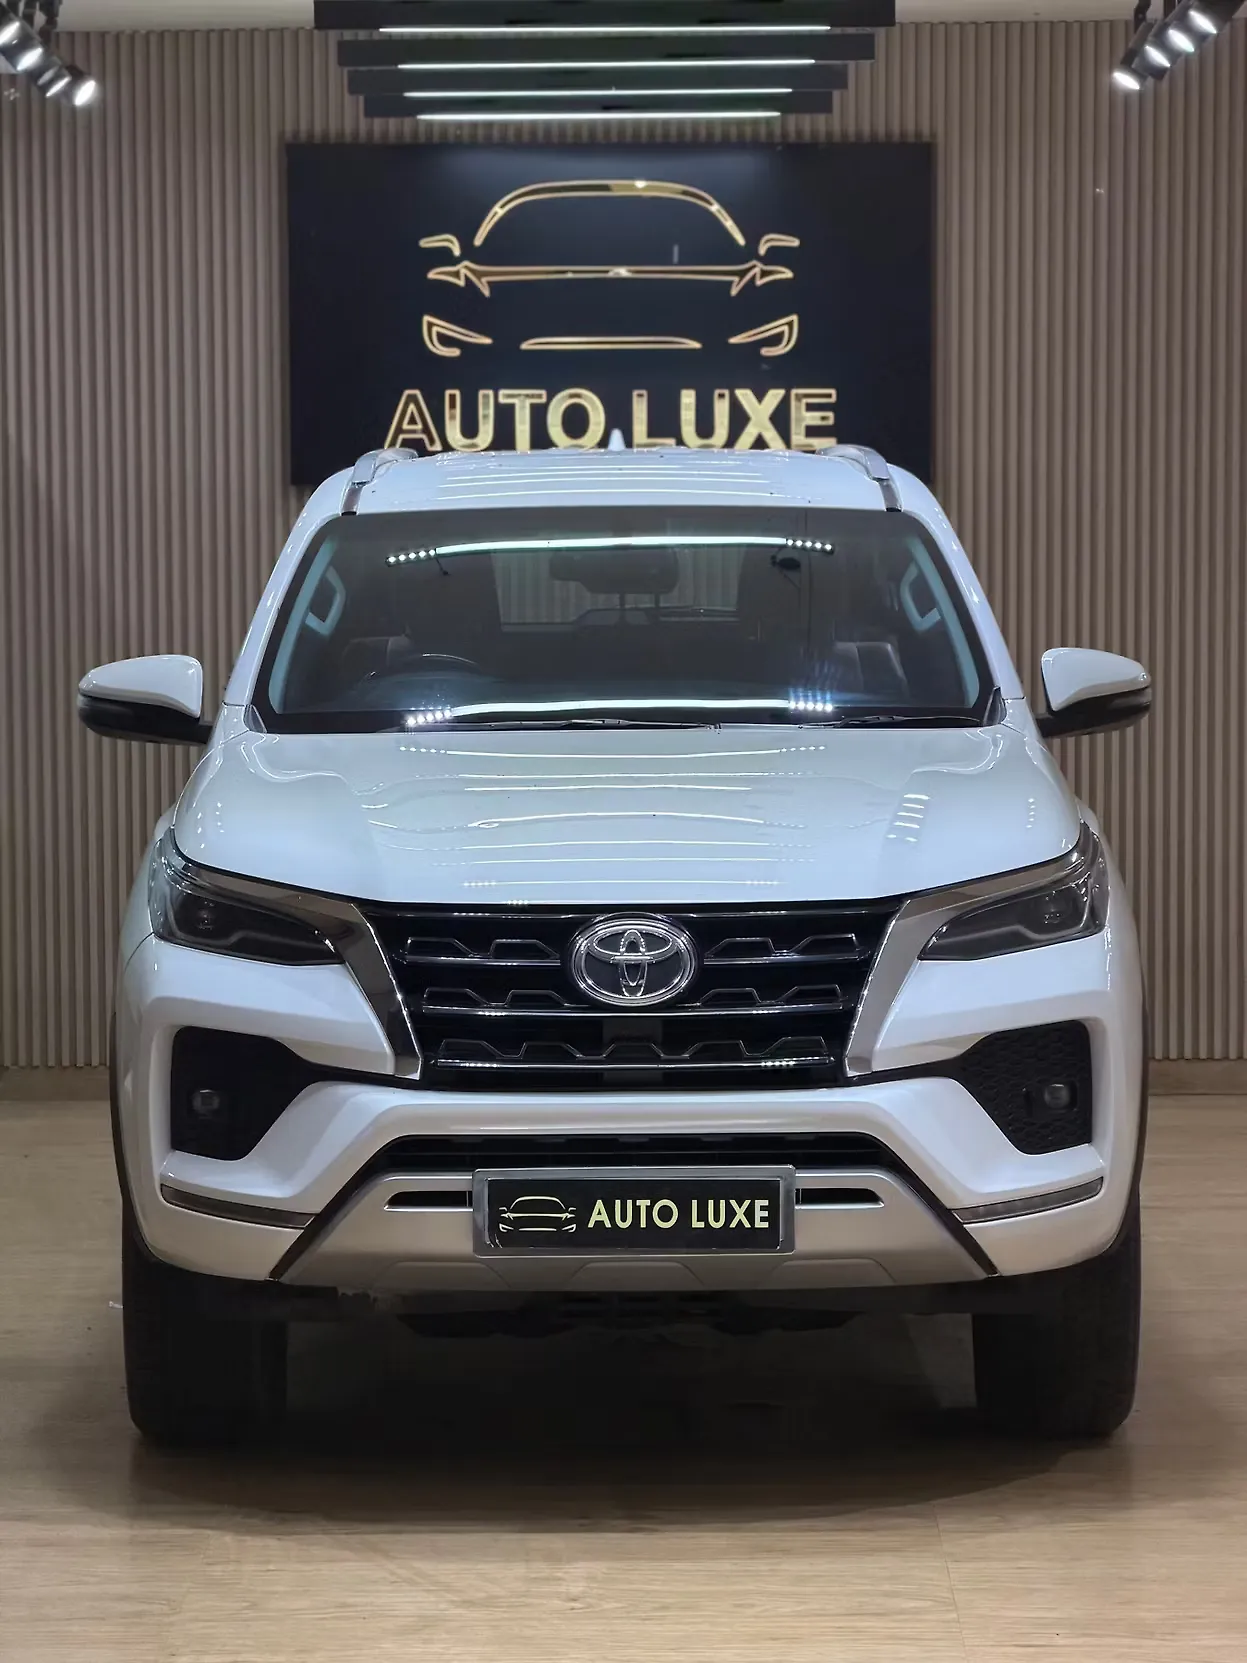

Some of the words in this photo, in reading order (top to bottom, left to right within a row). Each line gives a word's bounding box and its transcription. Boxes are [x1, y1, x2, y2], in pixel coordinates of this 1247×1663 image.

[384, 387, 606, 452] AUTO
[632, 388, 837, 450] LUXE
[587, 1199, 679, 1229] AUTO
[691, 1199, 770, 1229] LUXE
